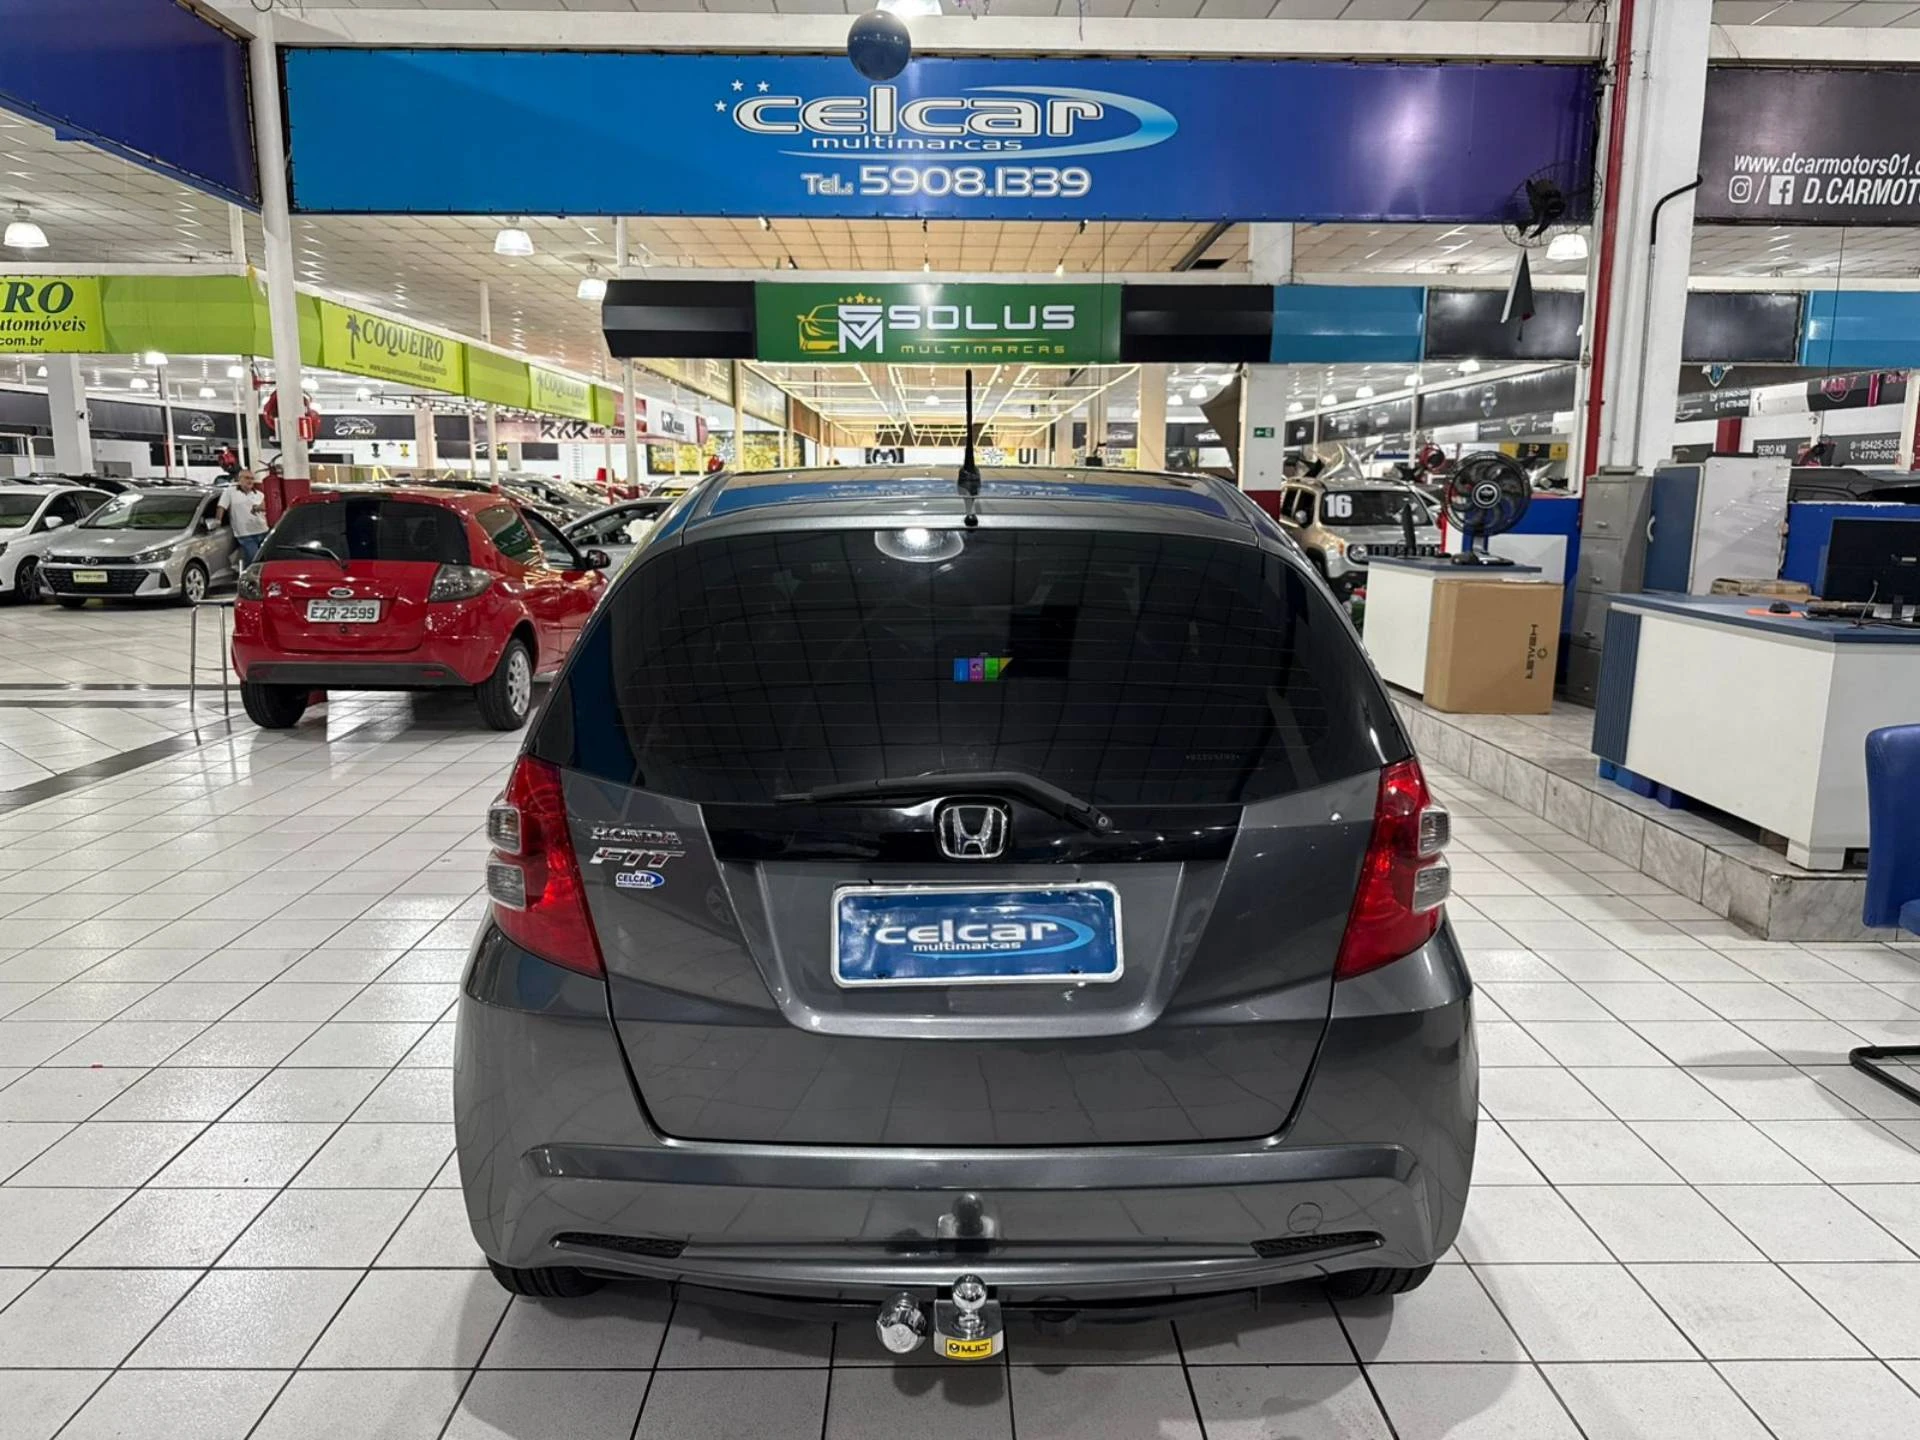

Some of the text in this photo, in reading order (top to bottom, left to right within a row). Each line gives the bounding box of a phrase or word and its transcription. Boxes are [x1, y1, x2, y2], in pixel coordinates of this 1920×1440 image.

[733, 84, 1104, 136] celcar
[812, 136, 1023, 151] multimarcas
[859, 166, 1093, 198] 5908.1339
[1803, 177, 1920, 205] D.CARMOT
[0, 281, 74, 314] RO
[889, 305, 1075, 330] SOLUS
[362, 319, 444, 362] COQUEIRO
[901, 345, 1065, 355] MULTIMARCAS
[1325, 494, 1352, 518] 16
[589, 847, 686, 868] FIT
[874, 919, 1059, 944] celcar
[912, 941, 1021, 953] multimarcas
